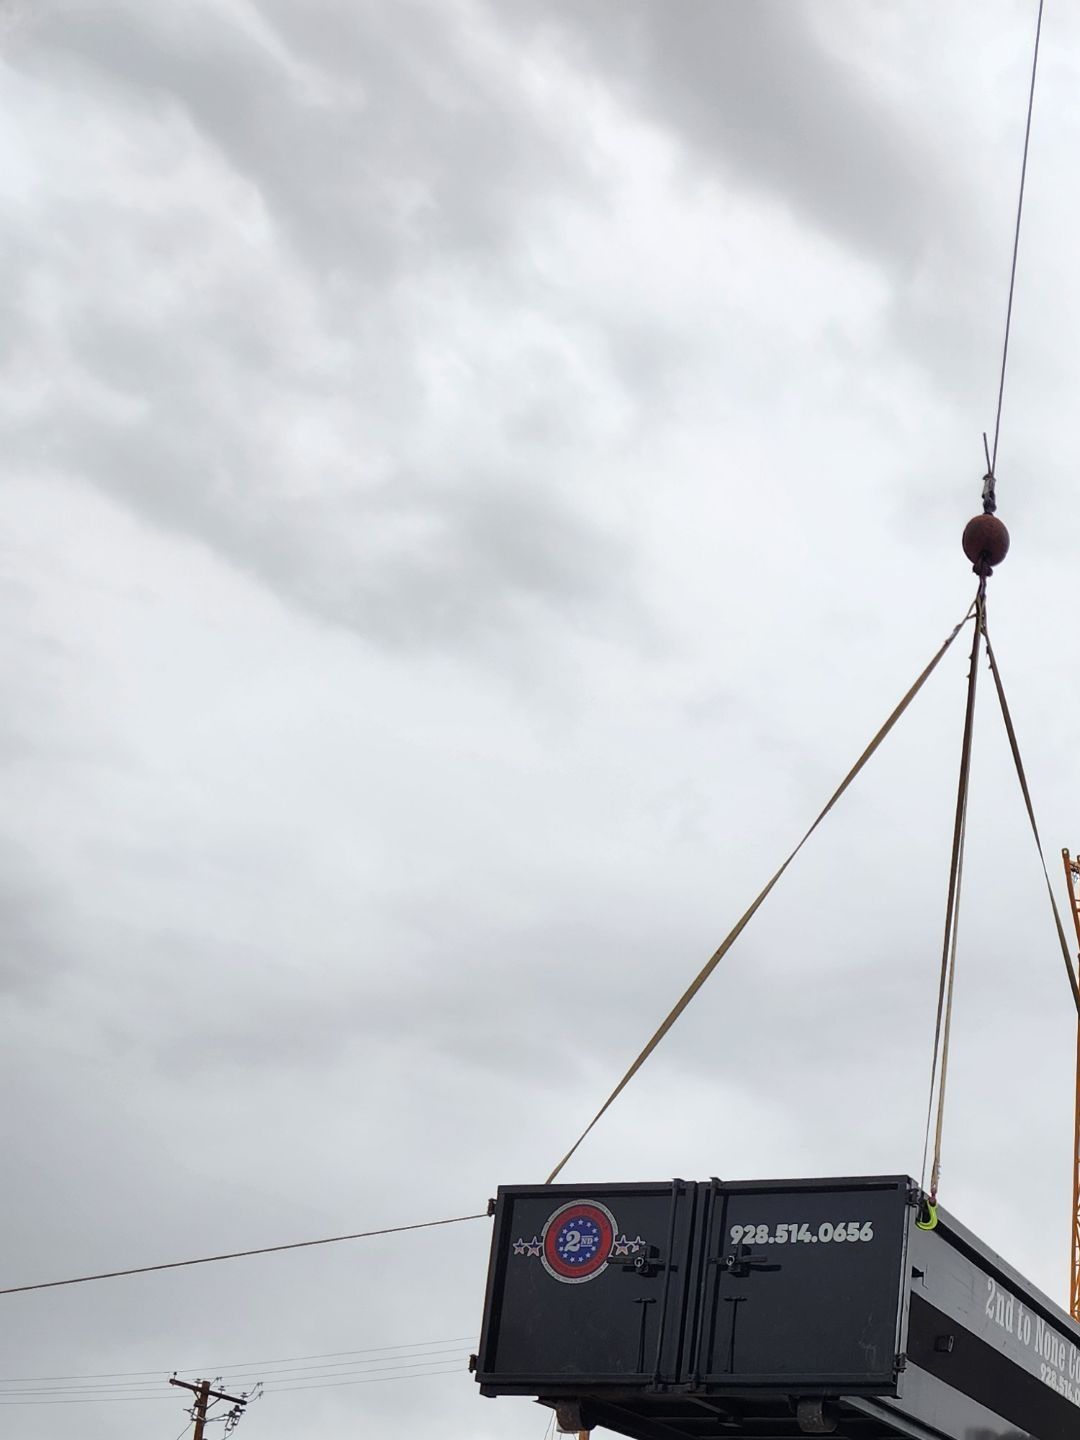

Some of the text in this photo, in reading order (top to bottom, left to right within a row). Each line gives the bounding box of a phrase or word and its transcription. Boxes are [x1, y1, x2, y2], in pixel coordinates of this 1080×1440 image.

[730, 1221, 874, 1245] 928.514.0656
[985, 1278, 1014, 1333] 2nd
[1017, 1303, 1032, 1346] to
[1034, 1315, 1066, 1372] None
